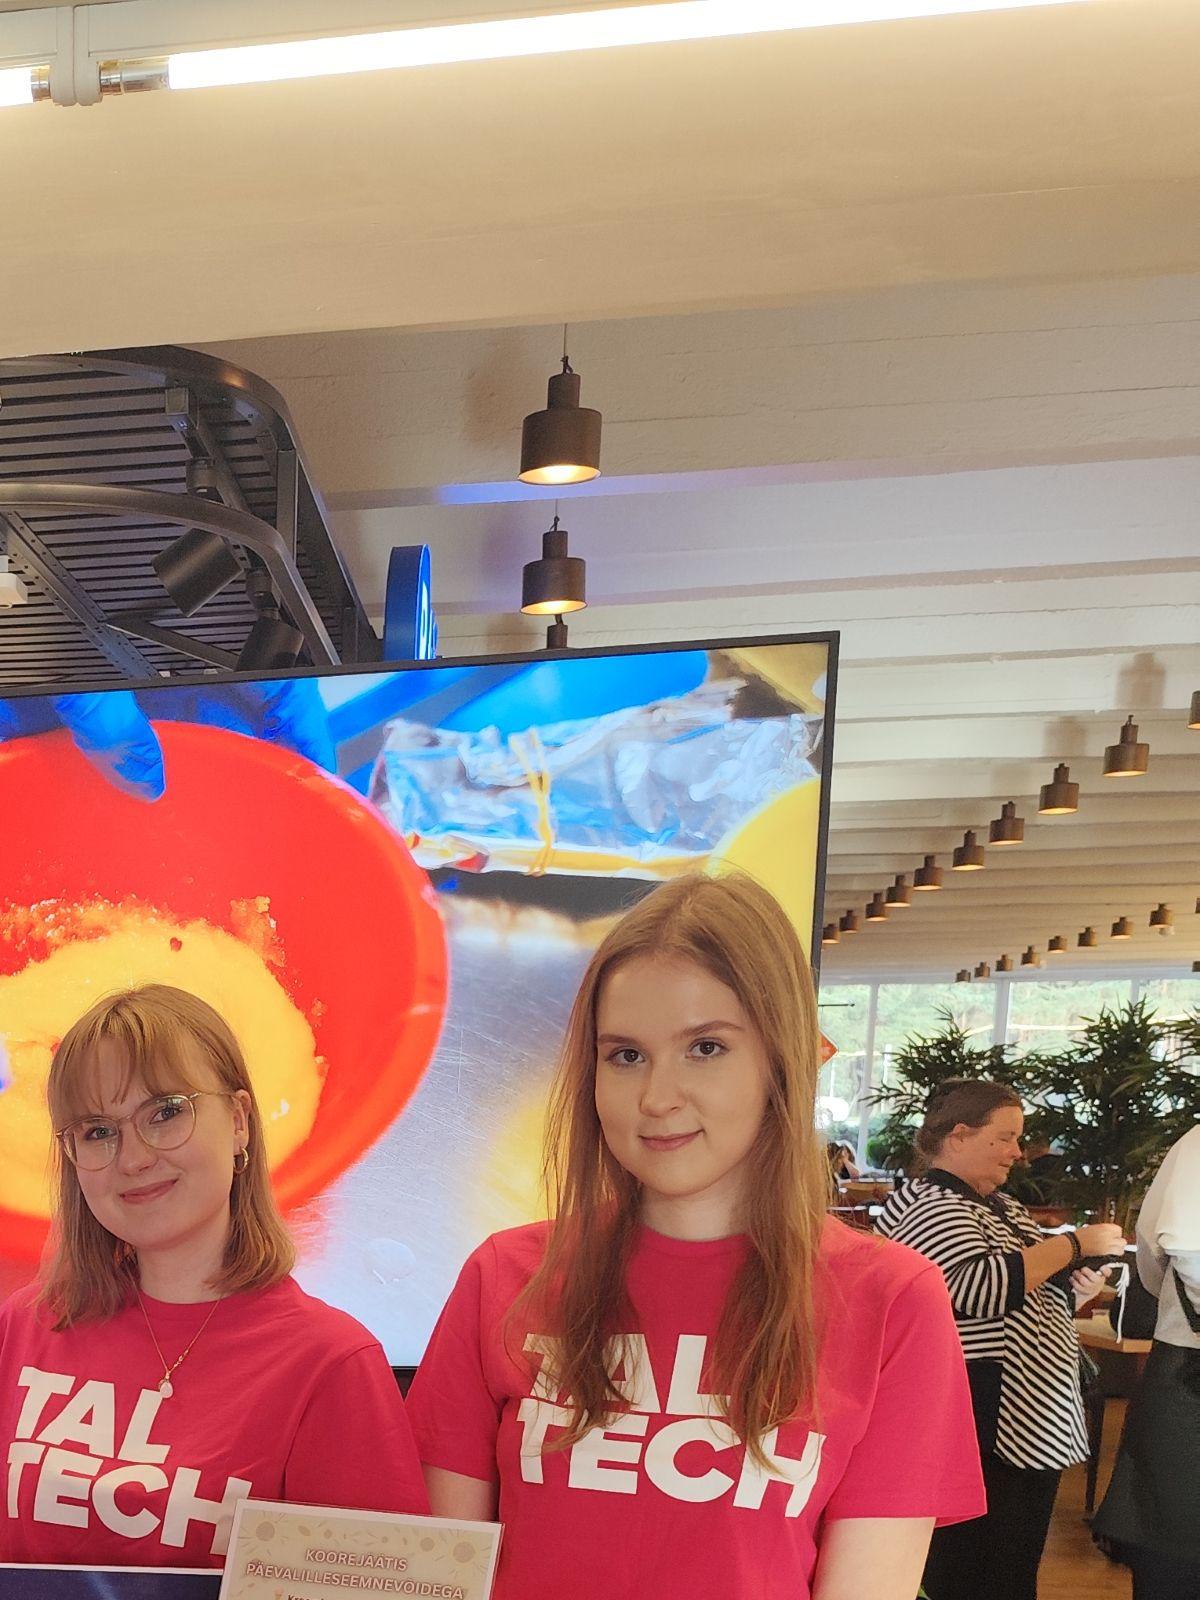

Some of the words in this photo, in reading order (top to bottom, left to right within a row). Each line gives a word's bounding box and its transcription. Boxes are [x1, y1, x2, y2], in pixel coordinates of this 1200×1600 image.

[15, 1366, 171, 1464] TAL
[522, 1333, 732, 1416] TAL
[7, 1442, 252, 1555] TECH
[517, 1398, 826, 1518] TECH
[245, 1561, 465, 1600] PÄEVALILLESEEMNEVÕIDEGA
